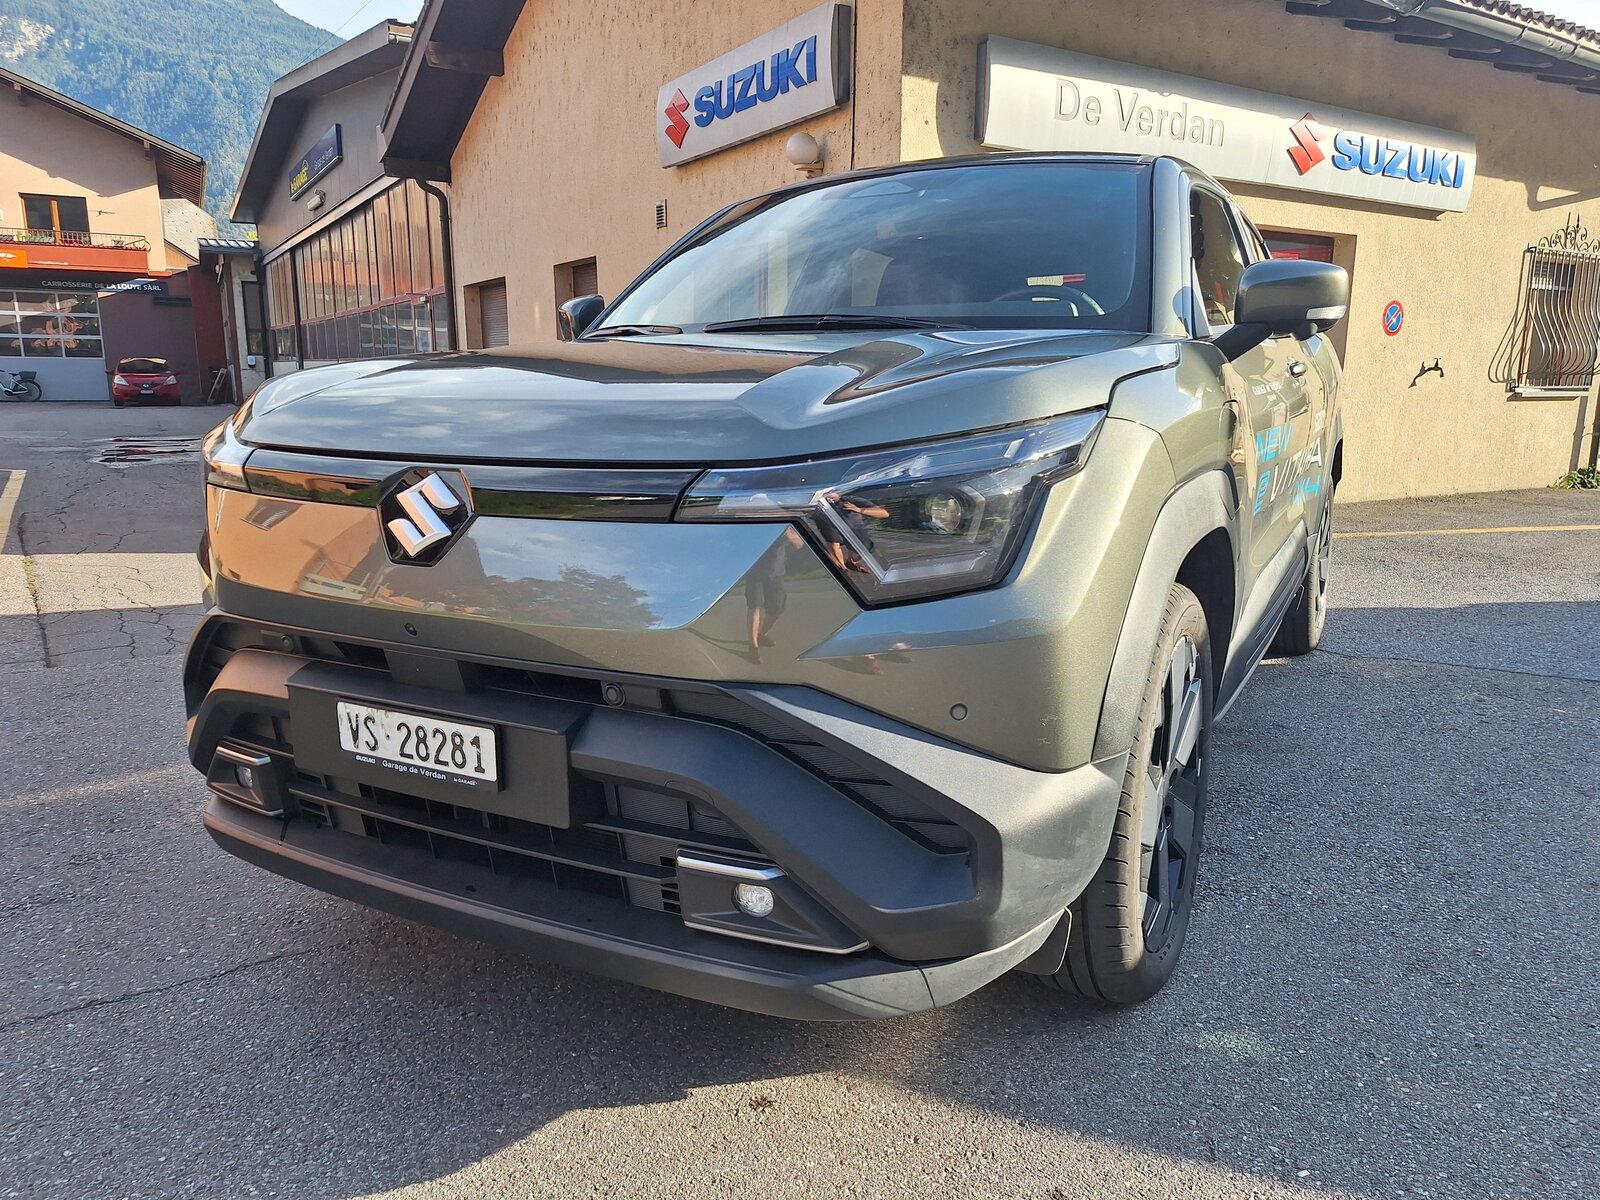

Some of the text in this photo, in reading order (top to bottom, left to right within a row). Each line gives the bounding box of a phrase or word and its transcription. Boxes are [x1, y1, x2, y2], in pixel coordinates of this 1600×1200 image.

[694, 35, 817, 128] SUZUKI
[1054, 78, 1225, 147] De Verdan
[1331, 131, 1465, 189] SUZUKI
[41, 280, 92, 289] CARROSSERIE
[346, 711, 486, 774] VS 28281
[355, 754, 376, 764] SUZUKI
[382, 760, 408, 772] Garage
[409, 766, 419, 774] de
[420, 767, 447, 780] Verdan
